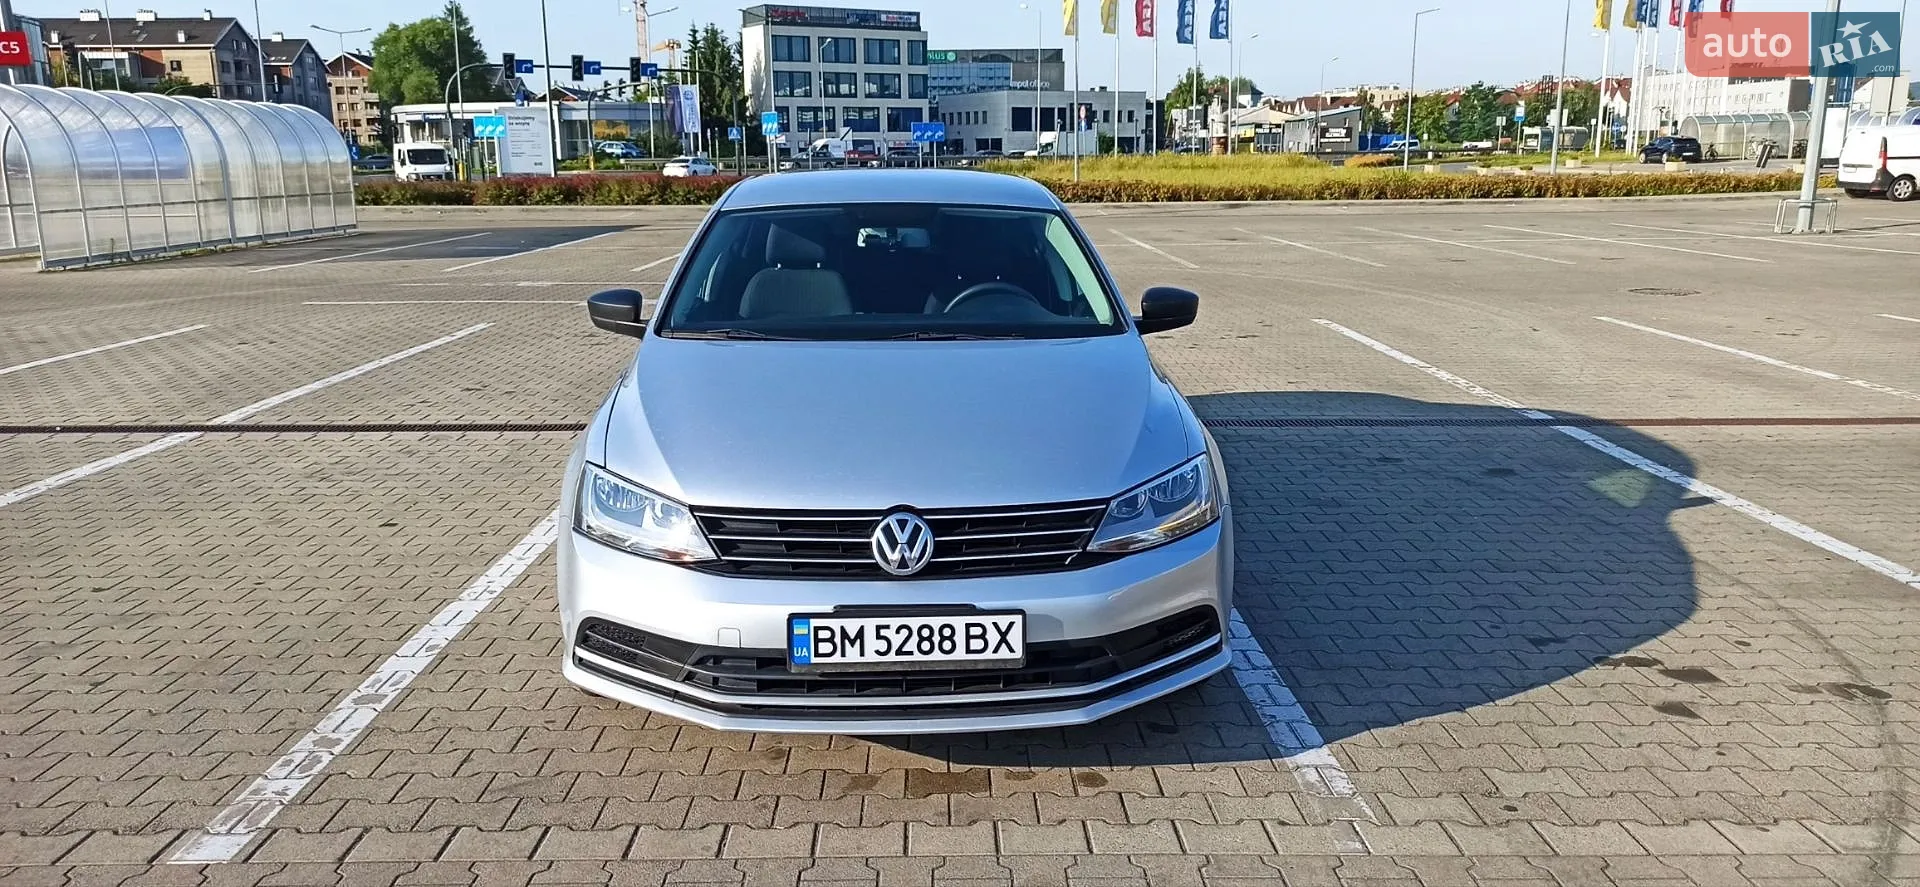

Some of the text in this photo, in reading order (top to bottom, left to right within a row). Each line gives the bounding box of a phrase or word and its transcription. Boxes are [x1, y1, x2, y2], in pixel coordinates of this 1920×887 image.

[0, 41, 20, 54] C5
[813, 621, 1016, 658] BM 5288 BX
[794, 647, 809, 657] UA
